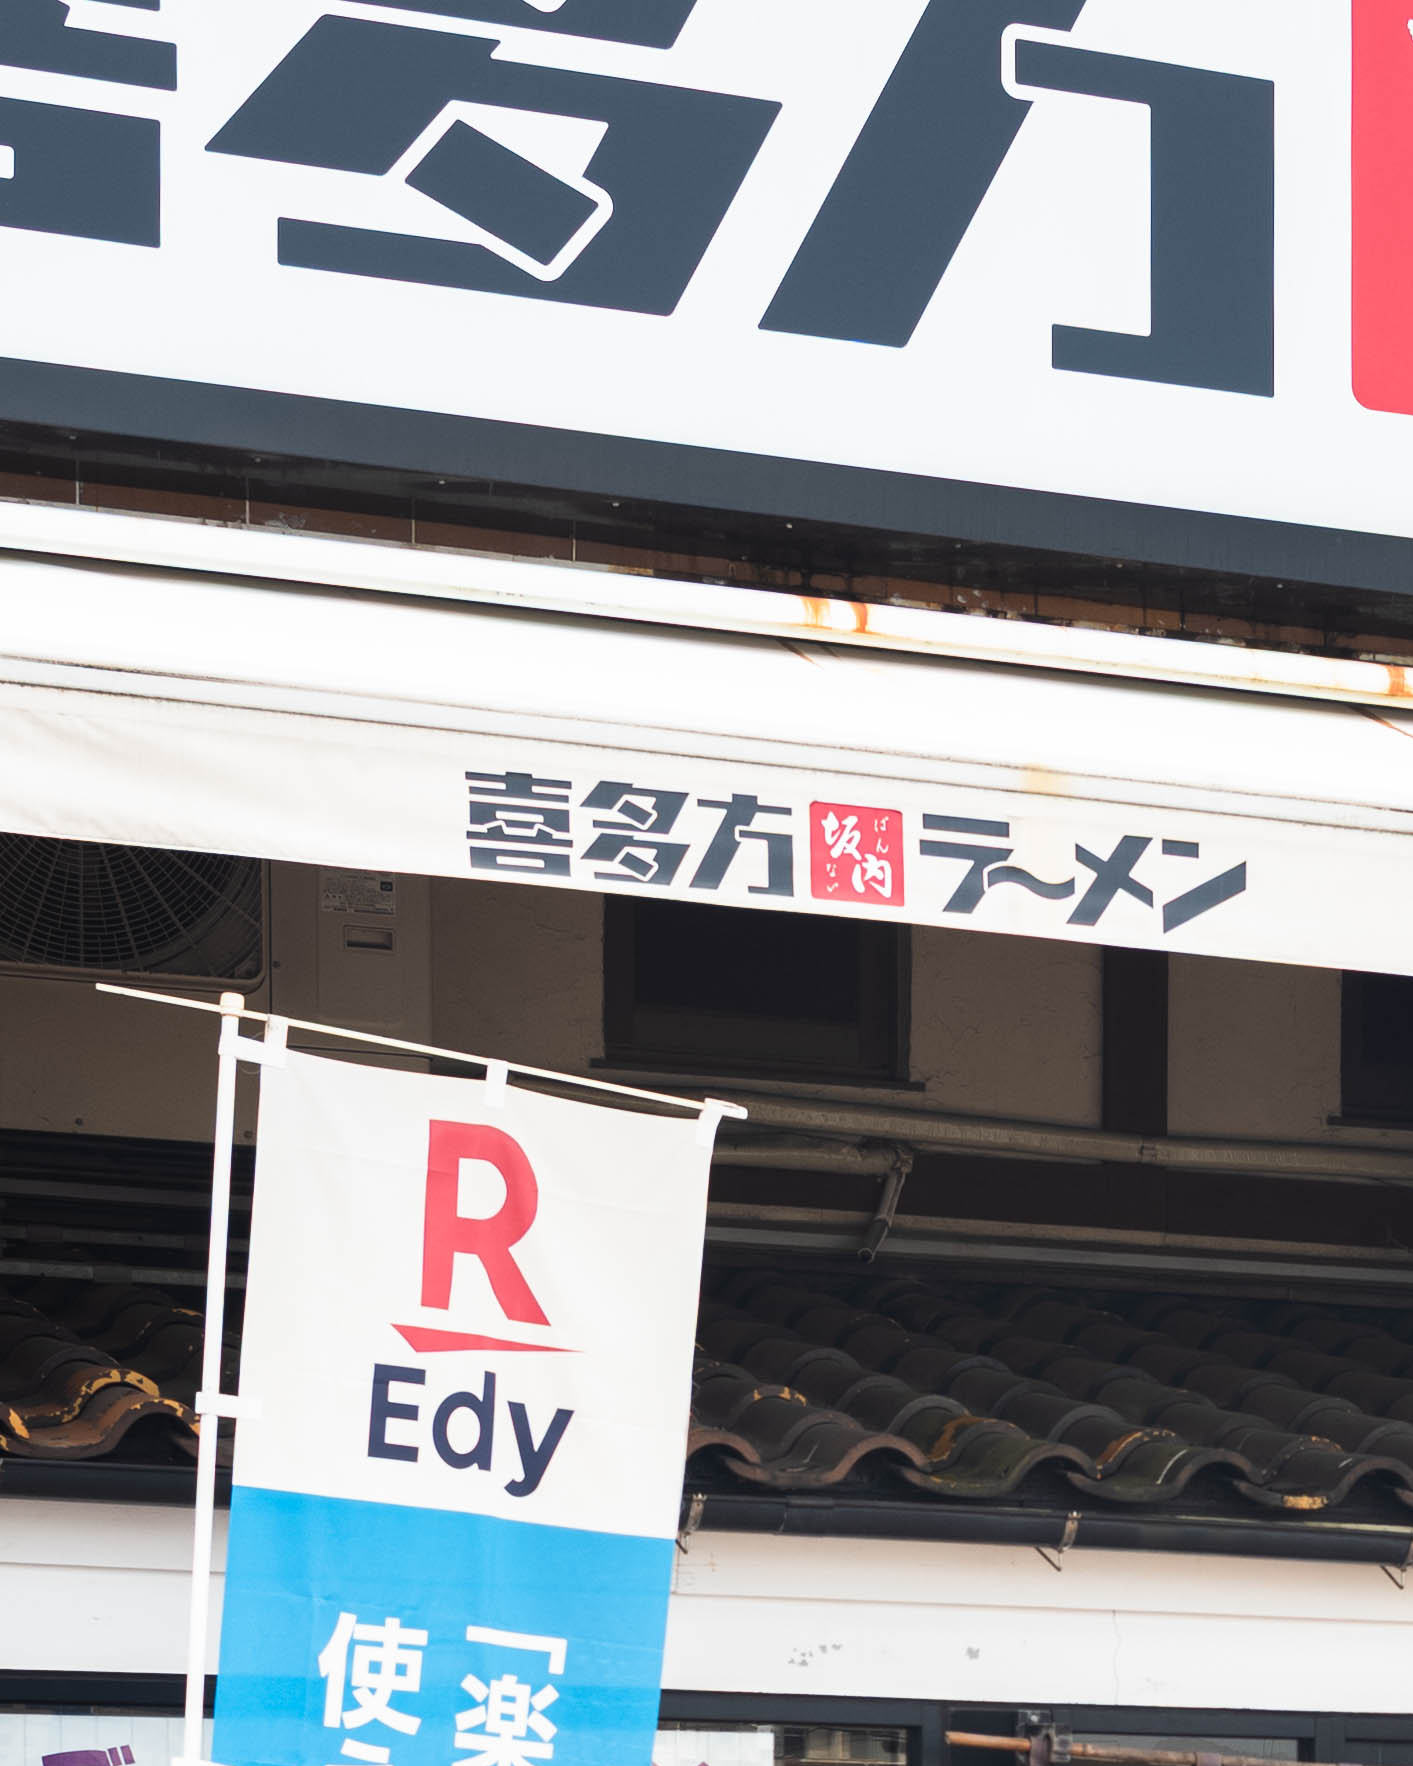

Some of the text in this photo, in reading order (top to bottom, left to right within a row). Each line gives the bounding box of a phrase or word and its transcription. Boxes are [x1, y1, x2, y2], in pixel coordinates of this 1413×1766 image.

[465, 772, 795, 898] 喜多方
[367, 1362, 575, 1498] Edy
